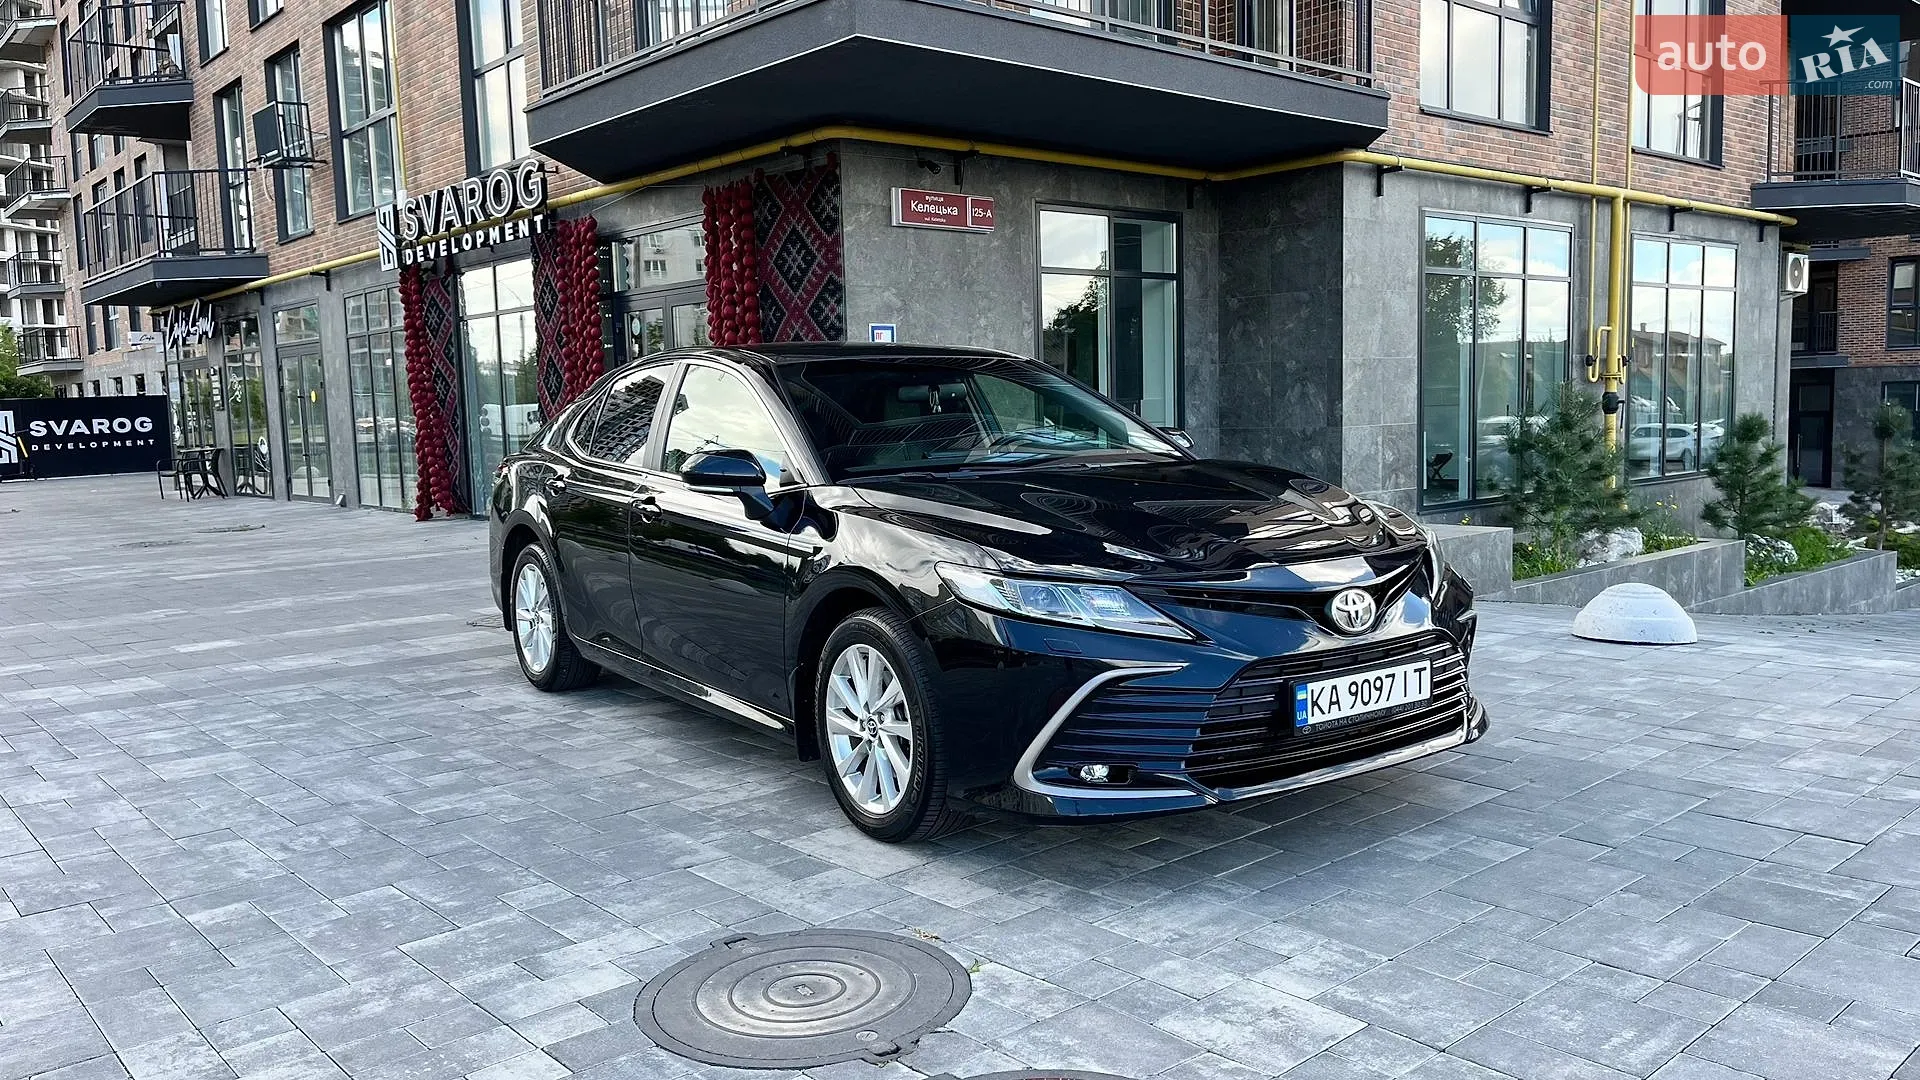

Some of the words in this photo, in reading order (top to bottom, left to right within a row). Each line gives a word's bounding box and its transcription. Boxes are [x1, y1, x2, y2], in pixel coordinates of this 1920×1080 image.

[402, 158, 545, 241] SVAROG
[911, 200, 958, 216] Келецька
[405, 214, 545, 266] DEVELOPMENT
[29, 416, 153, 437] SVAROG
[31, 439, 155, 451] DEVELOPMENT
[1311, 685, 1342, 717] KA
[1348, 673, 1396, 709] 9097
[1296, 712, 1307, 721] UA
